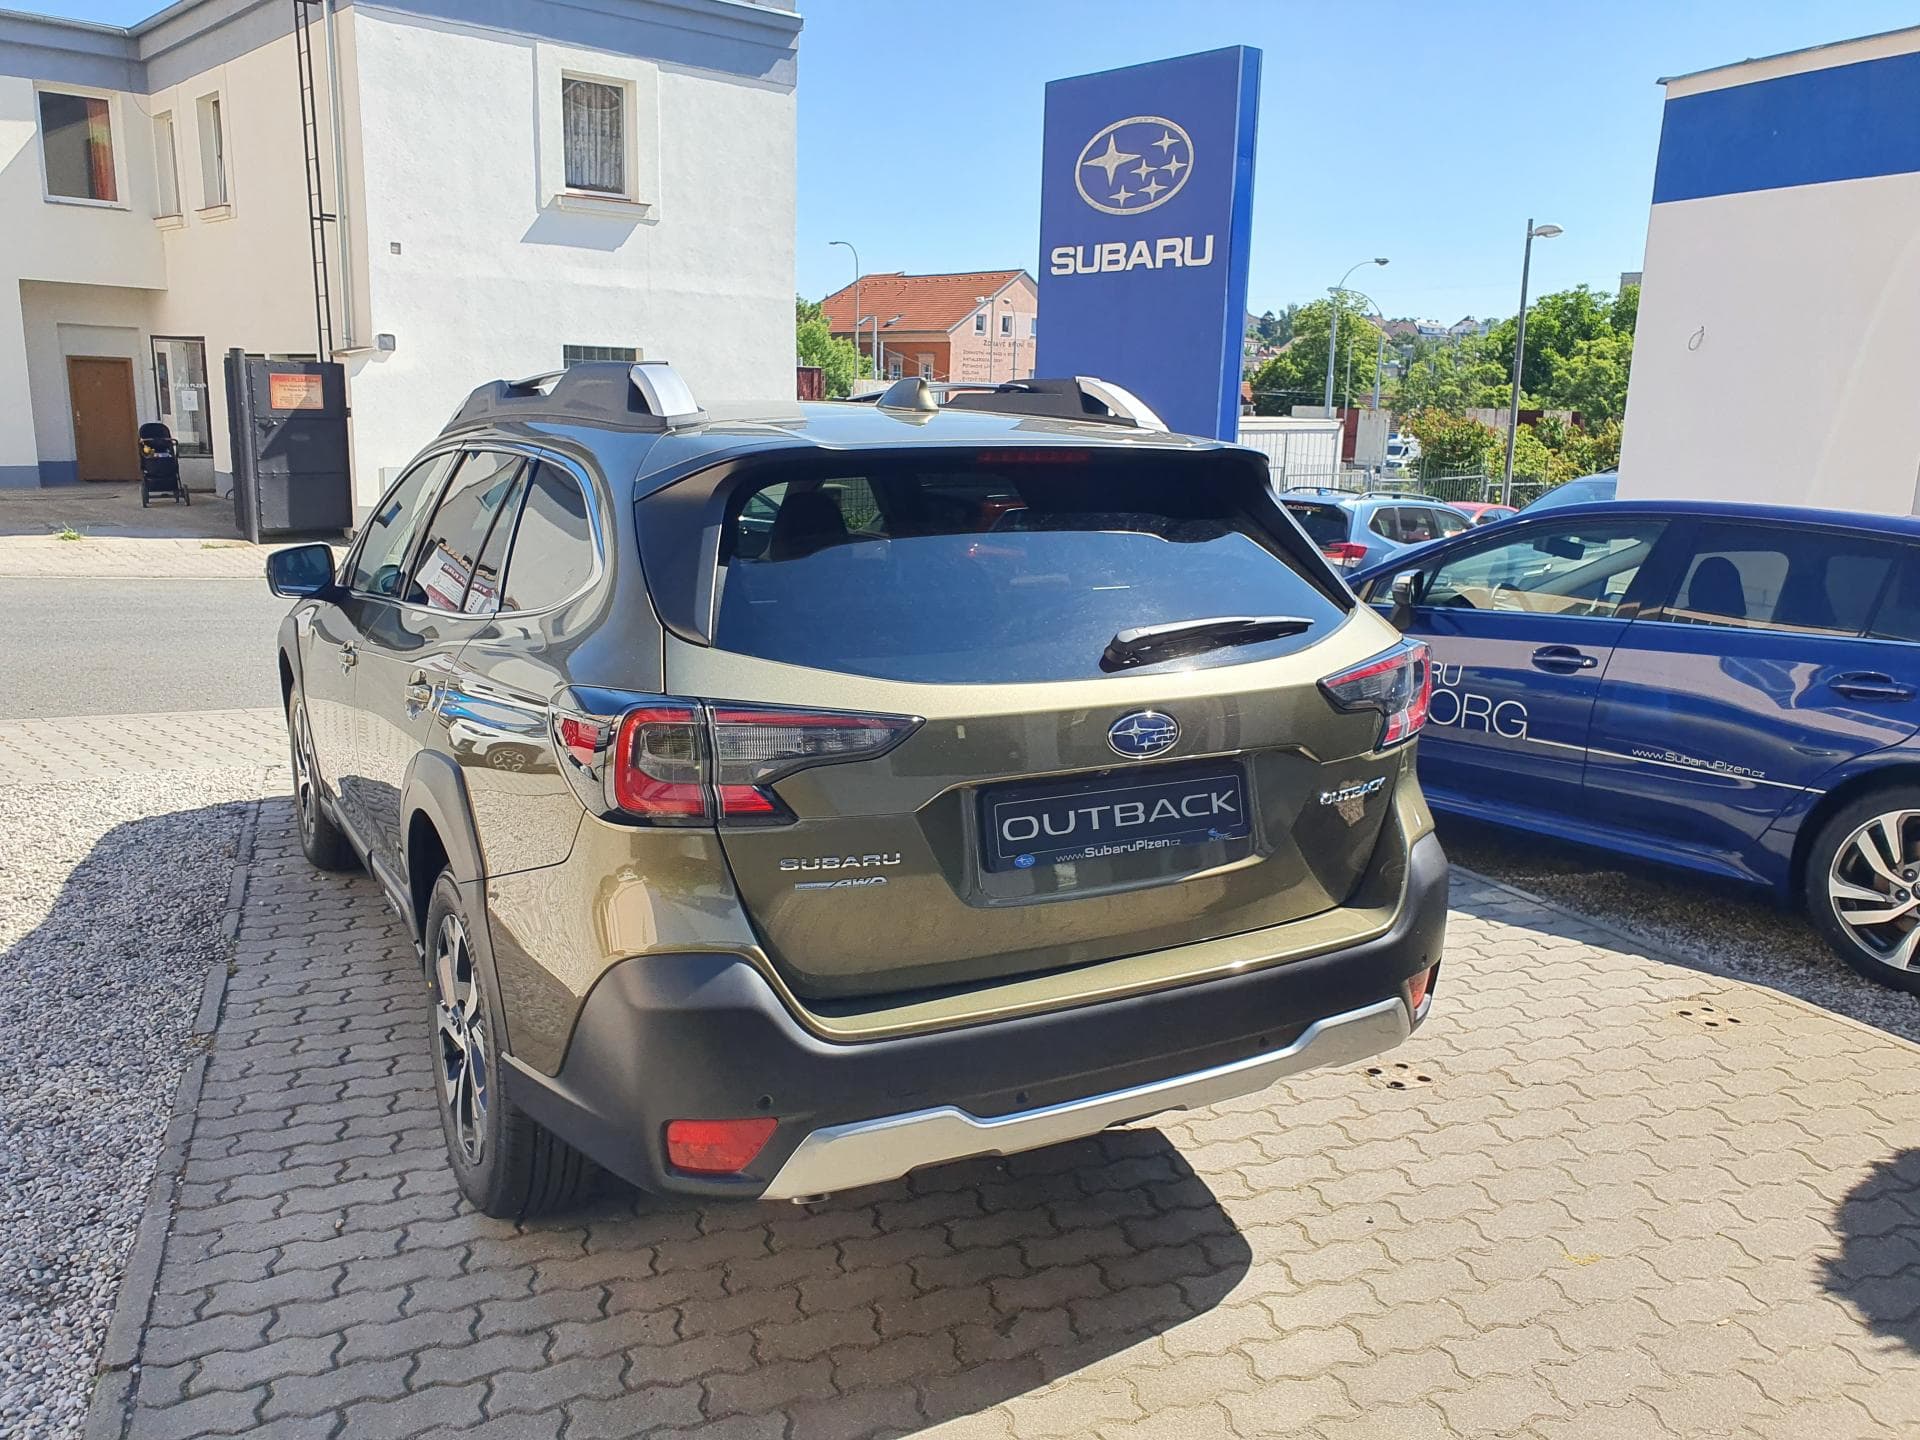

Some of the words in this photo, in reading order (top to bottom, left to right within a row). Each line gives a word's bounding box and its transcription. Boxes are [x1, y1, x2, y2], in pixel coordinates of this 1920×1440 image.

[1050, 234, 1214, 276] SUBARU
[1632, 748, 1766, 778] www.SubaruPlzen.cz
[1002, 790, 1237, 841] OUTBACK
[780, 852, 900, 870] SUBARU
[830, 876, 888, 888] AWD
